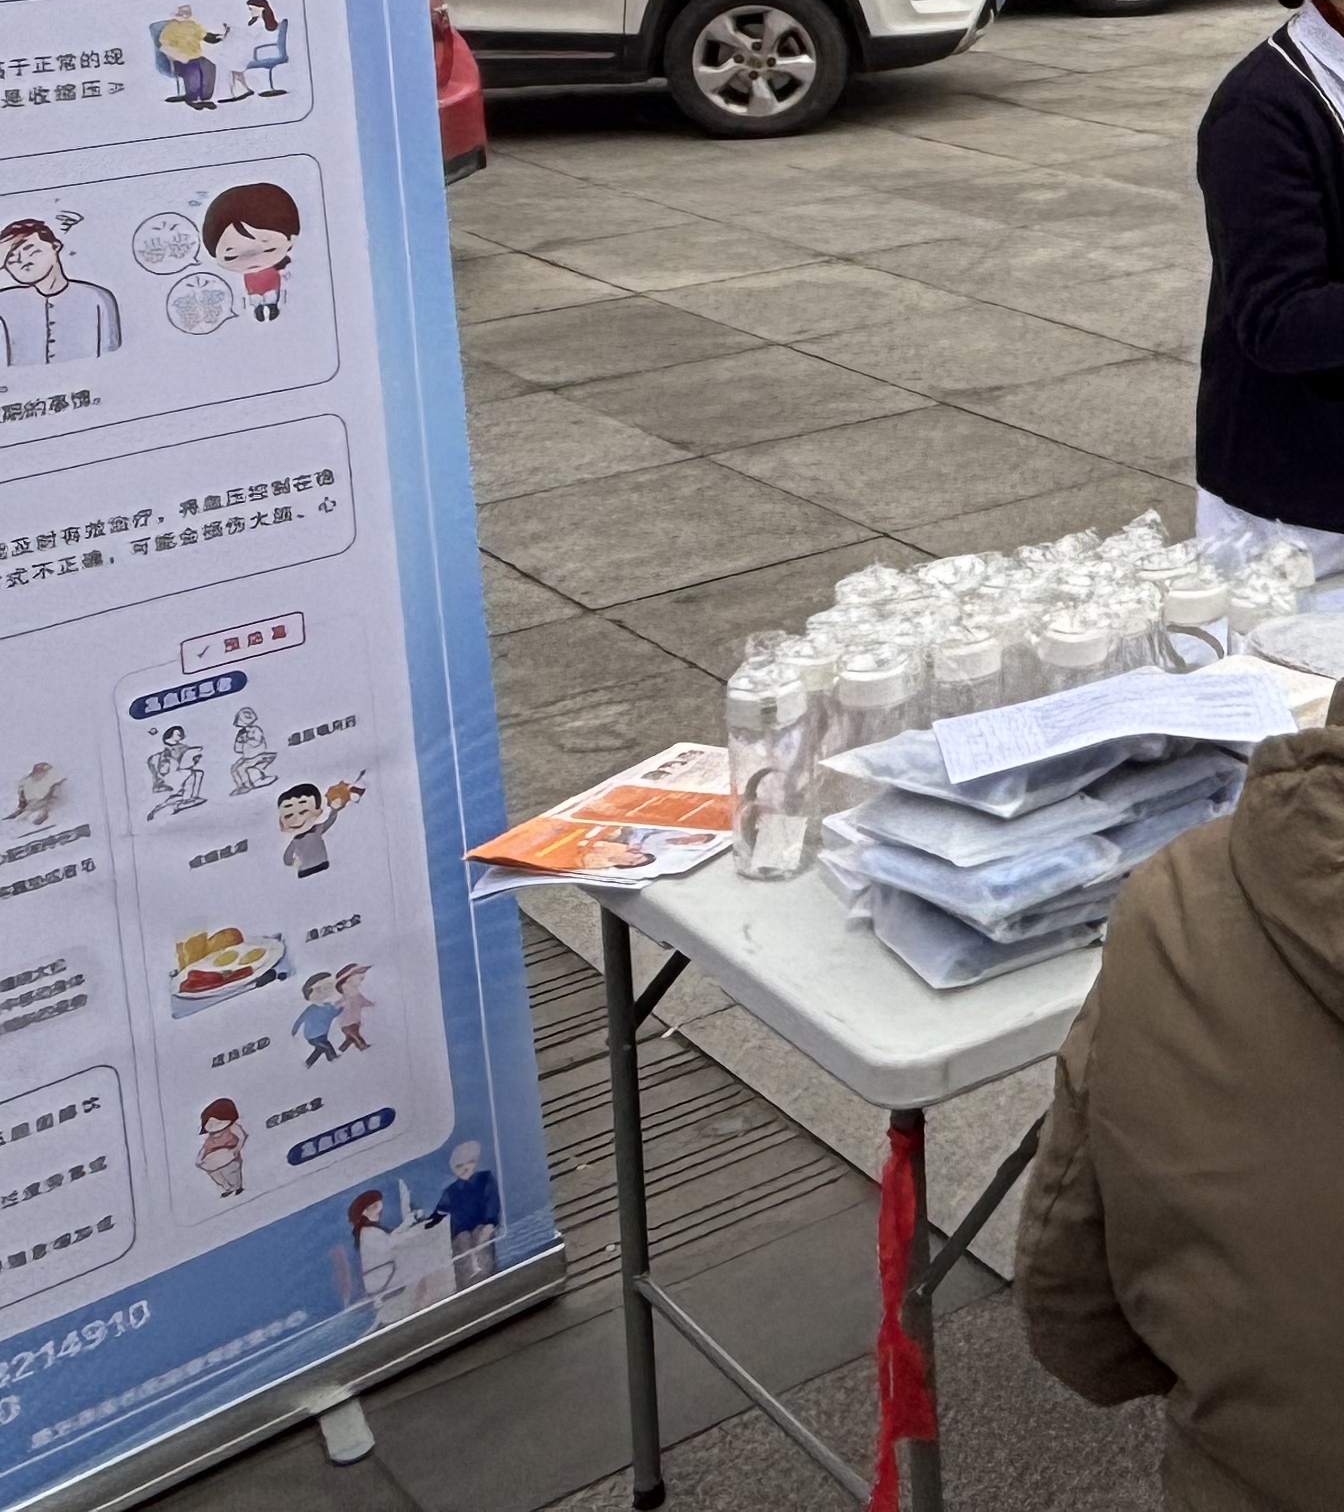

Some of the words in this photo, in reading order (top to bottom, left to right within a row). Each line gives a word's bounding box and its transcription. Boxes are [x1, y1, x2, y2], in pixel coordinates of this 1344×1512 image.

[0, 47, 126, 80] 于正常的现
